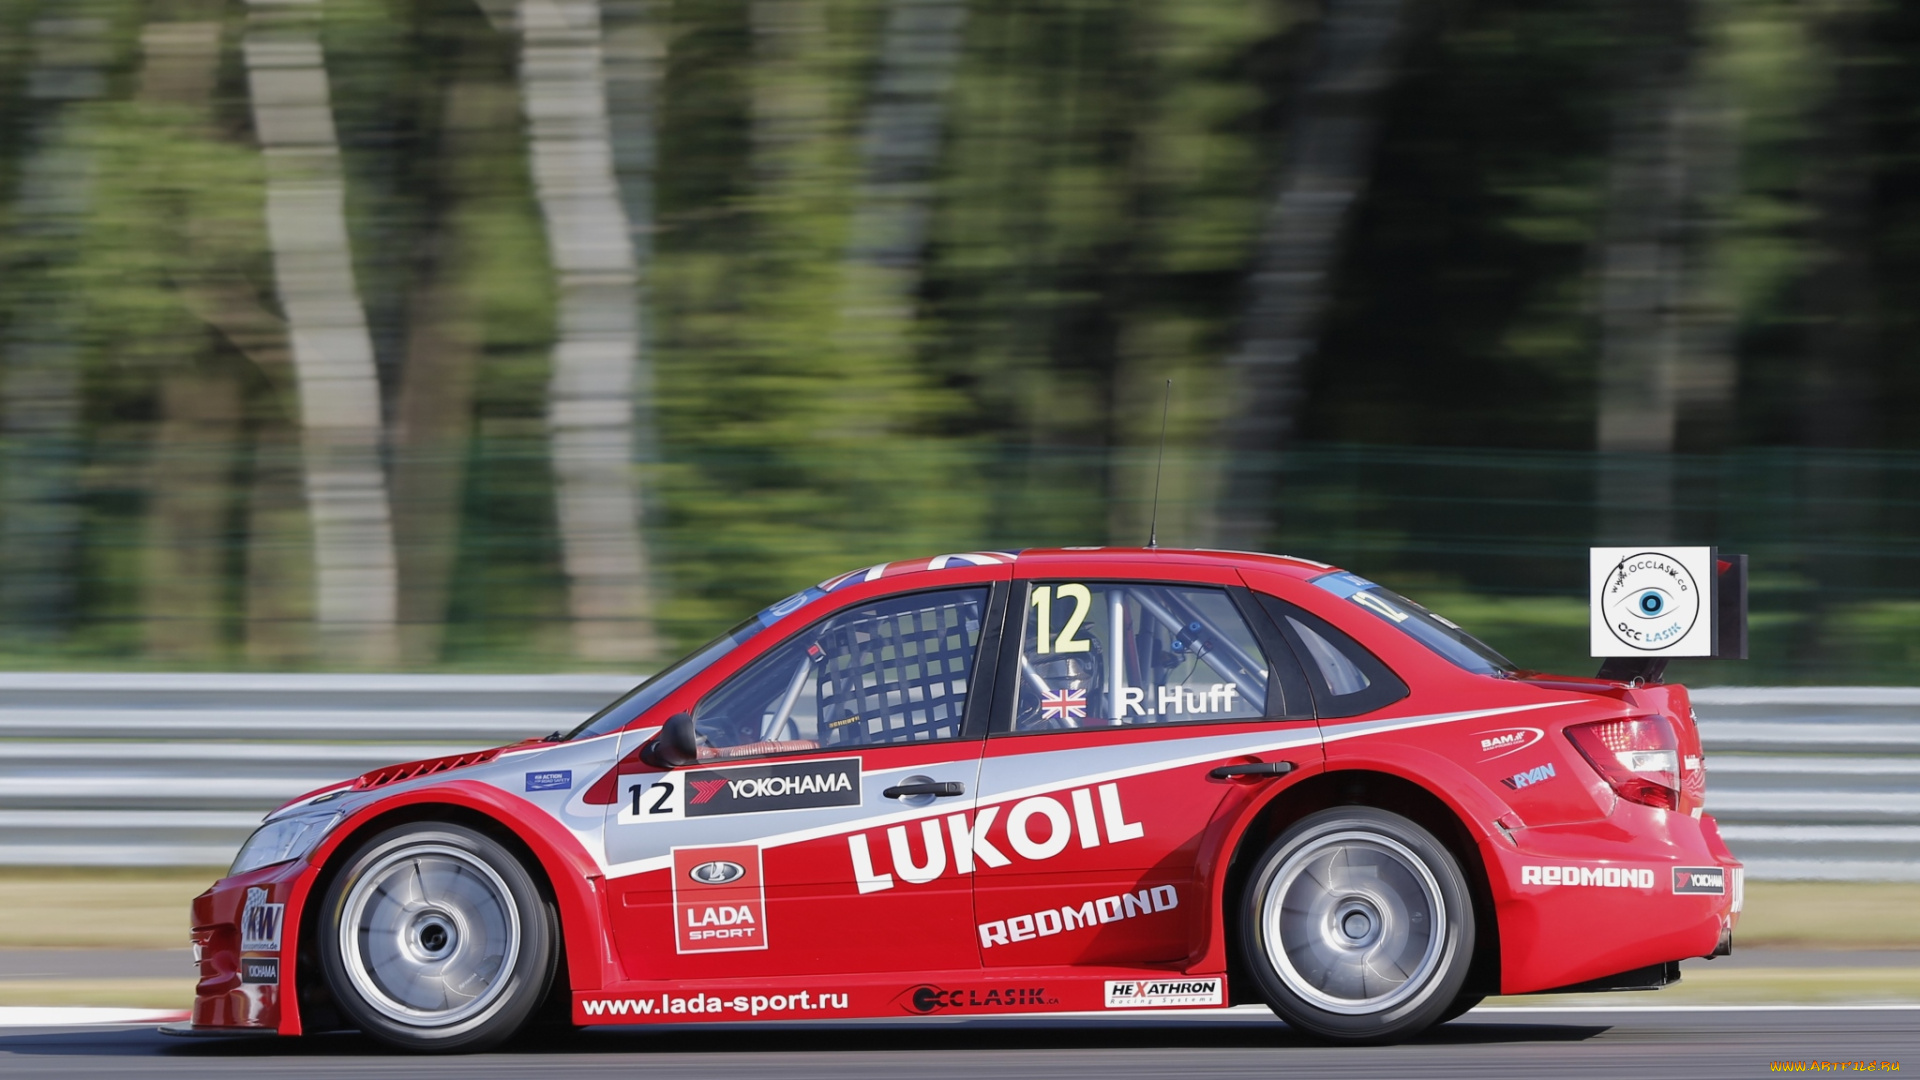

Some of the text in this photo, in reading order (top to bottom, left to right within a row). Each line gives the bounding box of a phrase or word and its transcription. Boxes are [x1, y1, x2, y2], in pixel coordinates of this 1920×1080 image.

[1031, 583, 1092, 655] 12
[1618, 622, 1682, 642] OCC LASIK
[1119, 682, 1237, 718] R.Huff
[1481, 734, 1514, 748] BAM
[728, 772, 852, 799] YOKOHAMA
[1513, 762, 1556, 789] RYAN
[628, 782, 675, 816] 12
[847, 782, 1145, 894] LUKOIL
[246, 906, 282, 941] KW
[688, 905, 755, 927] LADA
[689, 927, 756, 940] SPORT
[582, 990, 849, 1016] www.lada-sport.ru
[1112, 982, 1216, 998] HEXATHRON
[1162, 997, 1213, 1005] Systems
